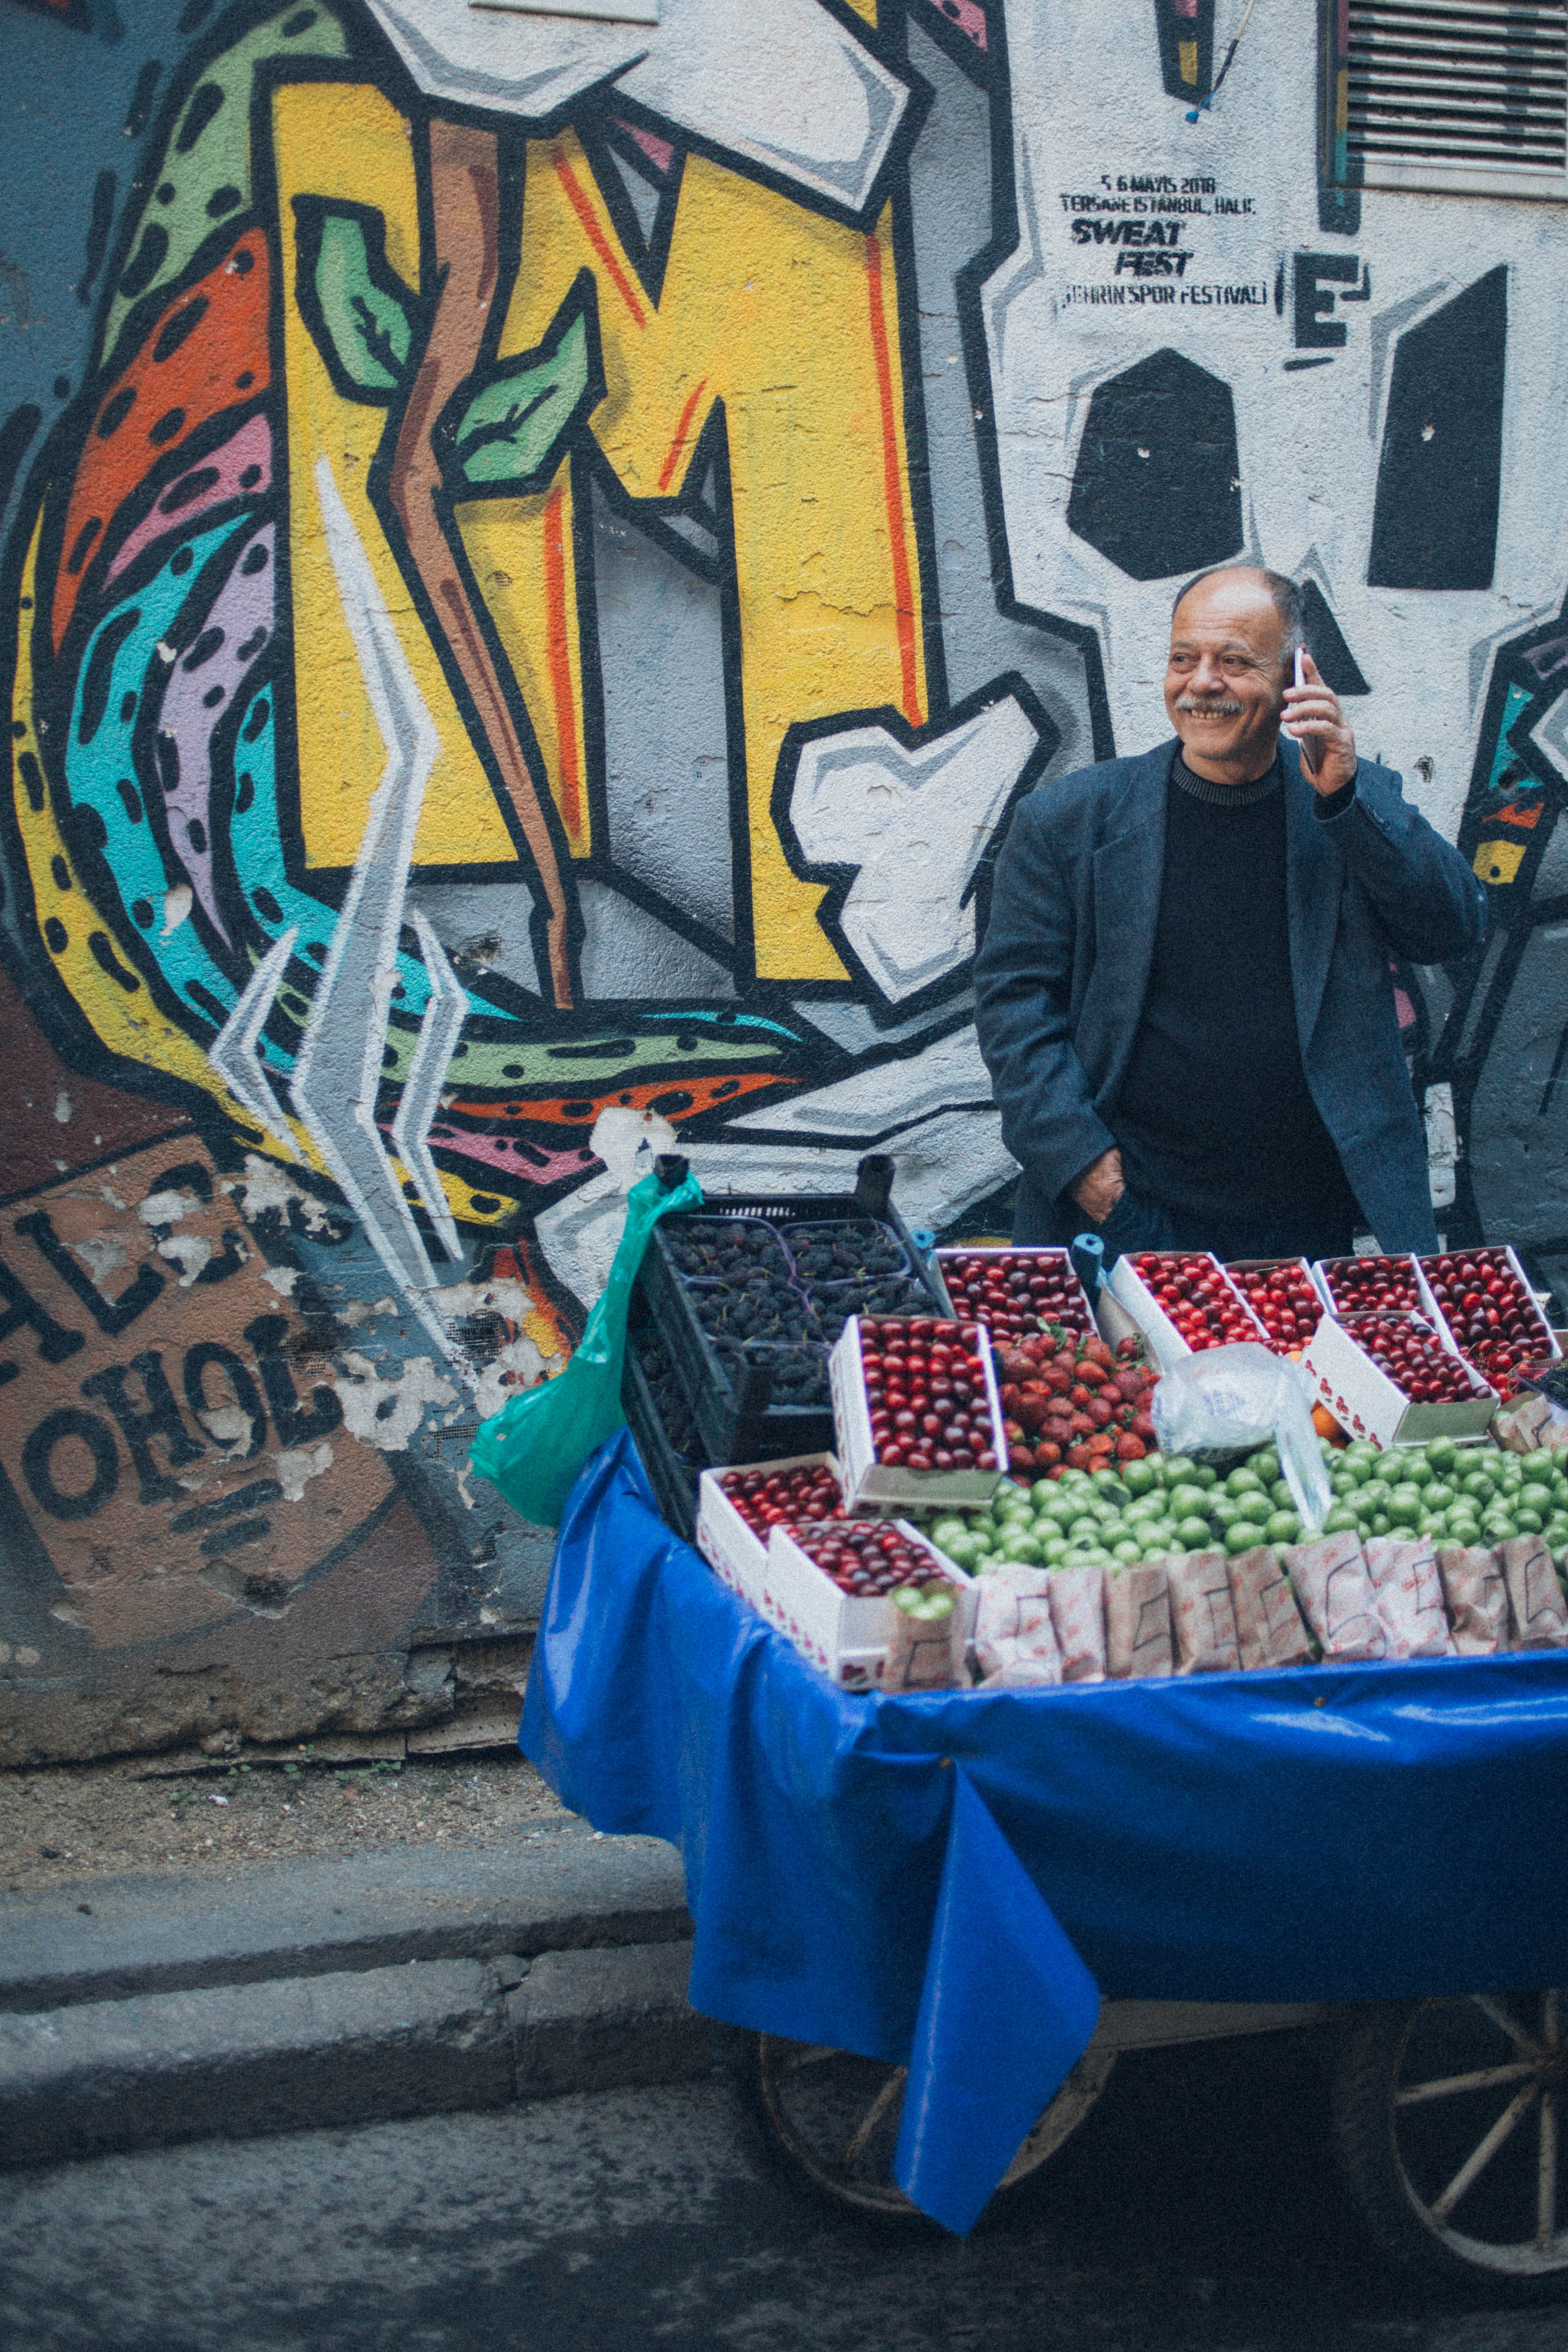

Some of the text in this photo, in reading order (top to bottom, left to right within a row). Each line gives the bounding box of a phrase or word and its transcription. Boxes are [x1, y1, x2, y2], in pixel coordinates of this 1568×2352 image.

[1071, 217, 1187, 246] SWEAT
[1114, 250, 1194, 277] FEST
[1127, 284, 1176, 304] SPOR
